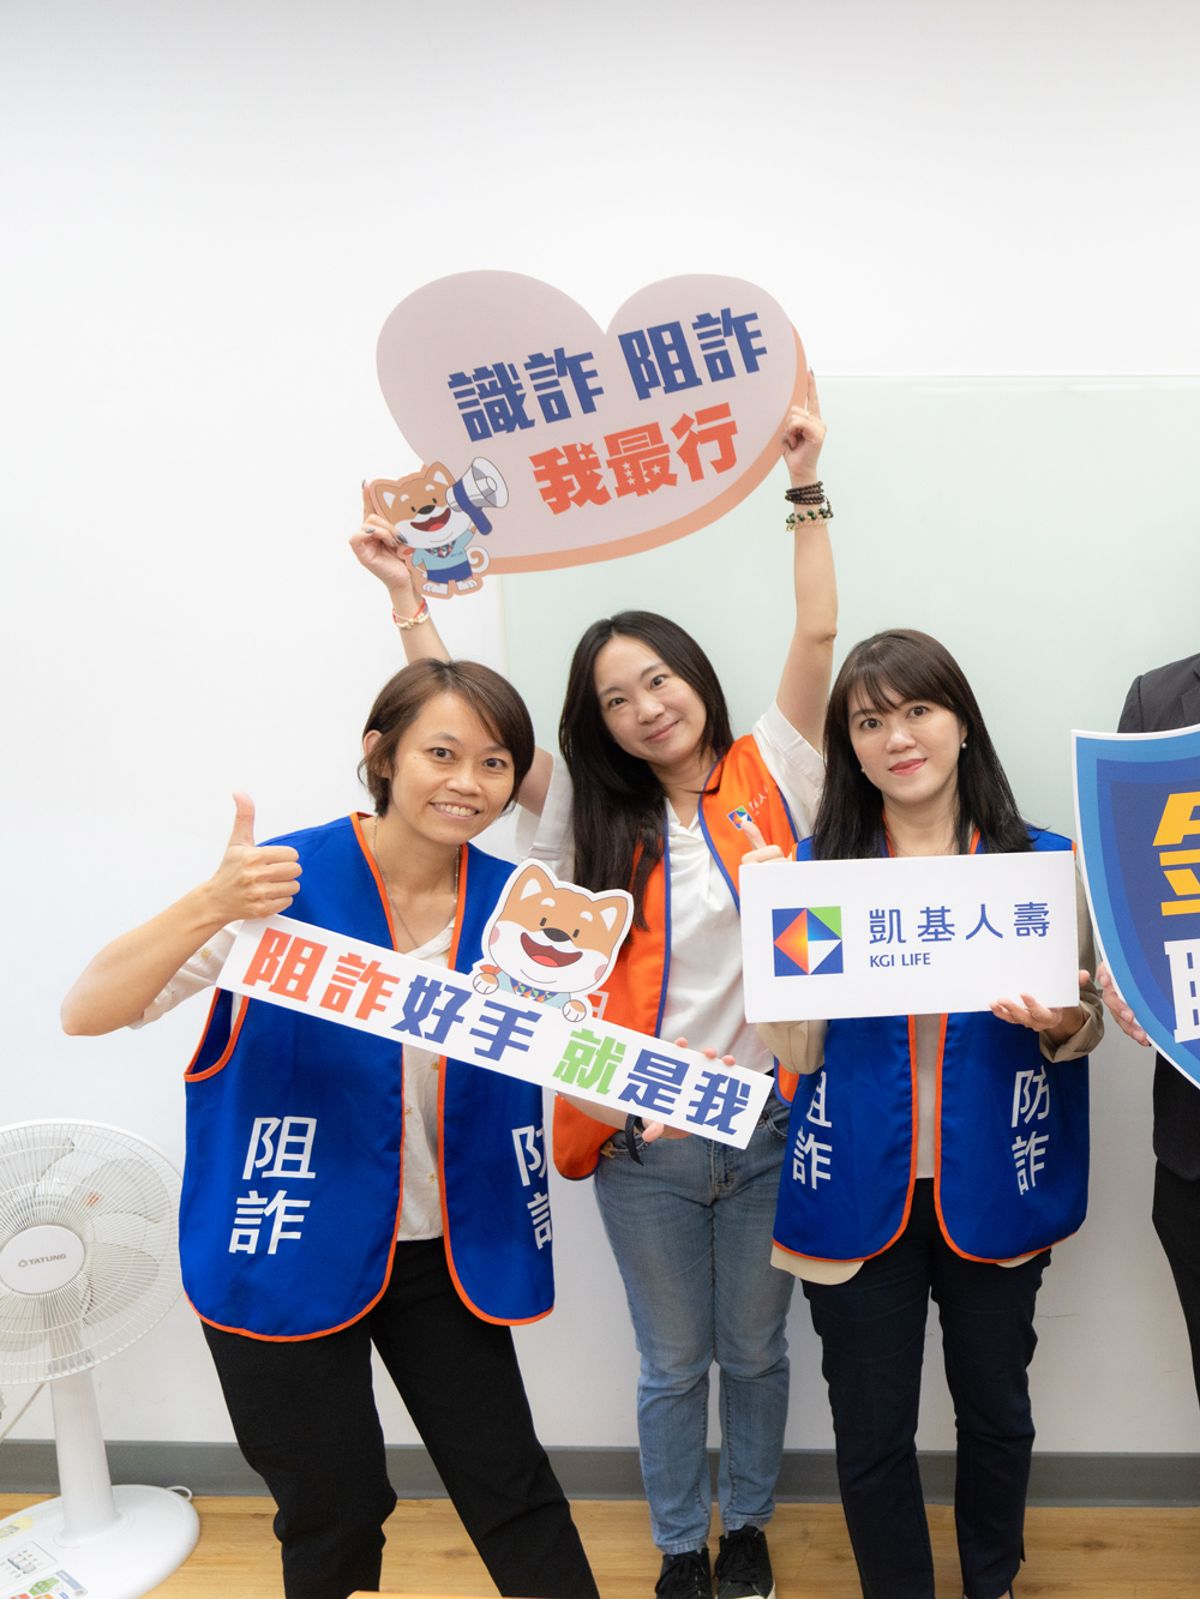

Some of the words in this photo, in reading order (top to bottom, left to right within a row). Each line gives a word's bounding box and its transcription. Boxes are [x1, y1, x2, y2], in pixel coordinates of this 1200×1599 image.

[447, 347, 604, 442] 識詐
[617, 307, 768, 401] 阻詐
[528, 402, 738, 515] 我最行
[868, 901, 1050, 945] 凱基人壽
[869, 954, 895, 968] KGI
[901, 952, 931, 967] LIFE
[242, 927, 541, 1061] 阻詐好手
[552, 1028, 752, 1136] 就是我
[228, 1115, 318, 1255] 阻詐
[1010, 1065, 1050, 1196] 防詐
